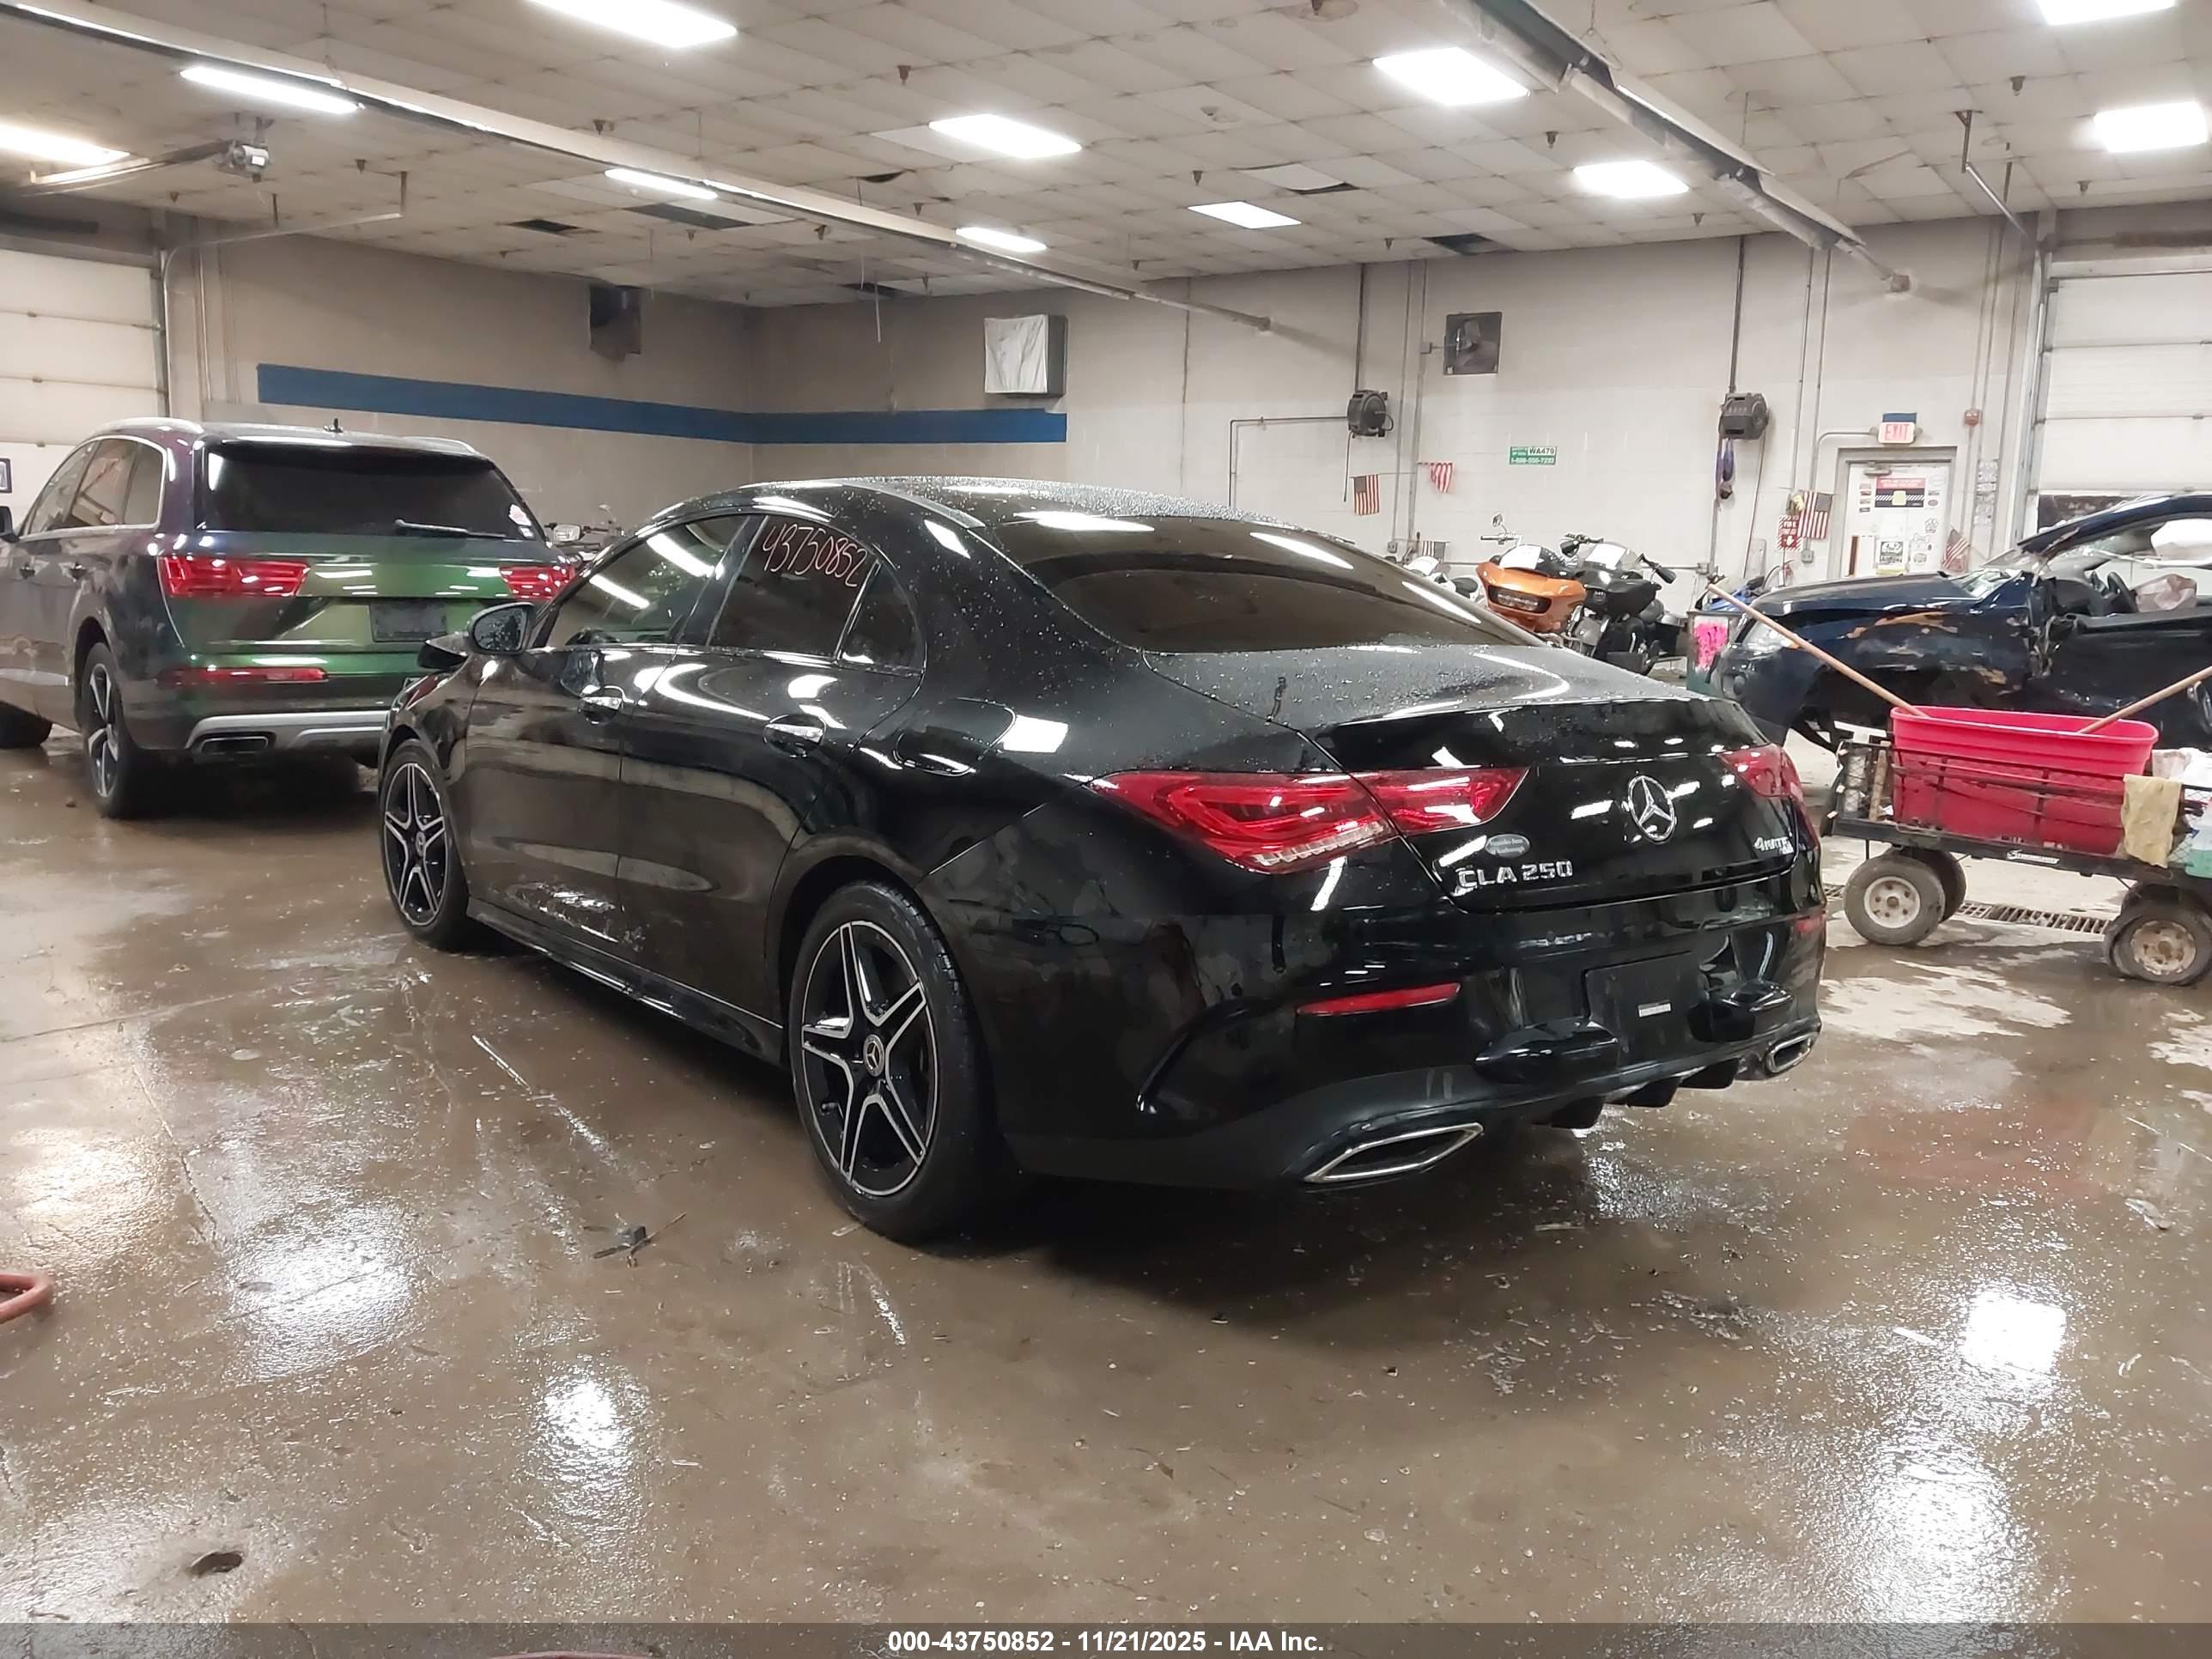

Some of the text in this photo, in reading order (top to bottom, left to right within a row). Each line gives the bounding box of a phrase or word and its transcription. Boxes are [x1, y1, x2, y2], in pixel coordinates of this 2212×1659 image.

[1885, 423, 1910, 441] EXIT
[763, 523, 868, 587] 43750852
[1458, 860, 1573, 888] CLA 250
